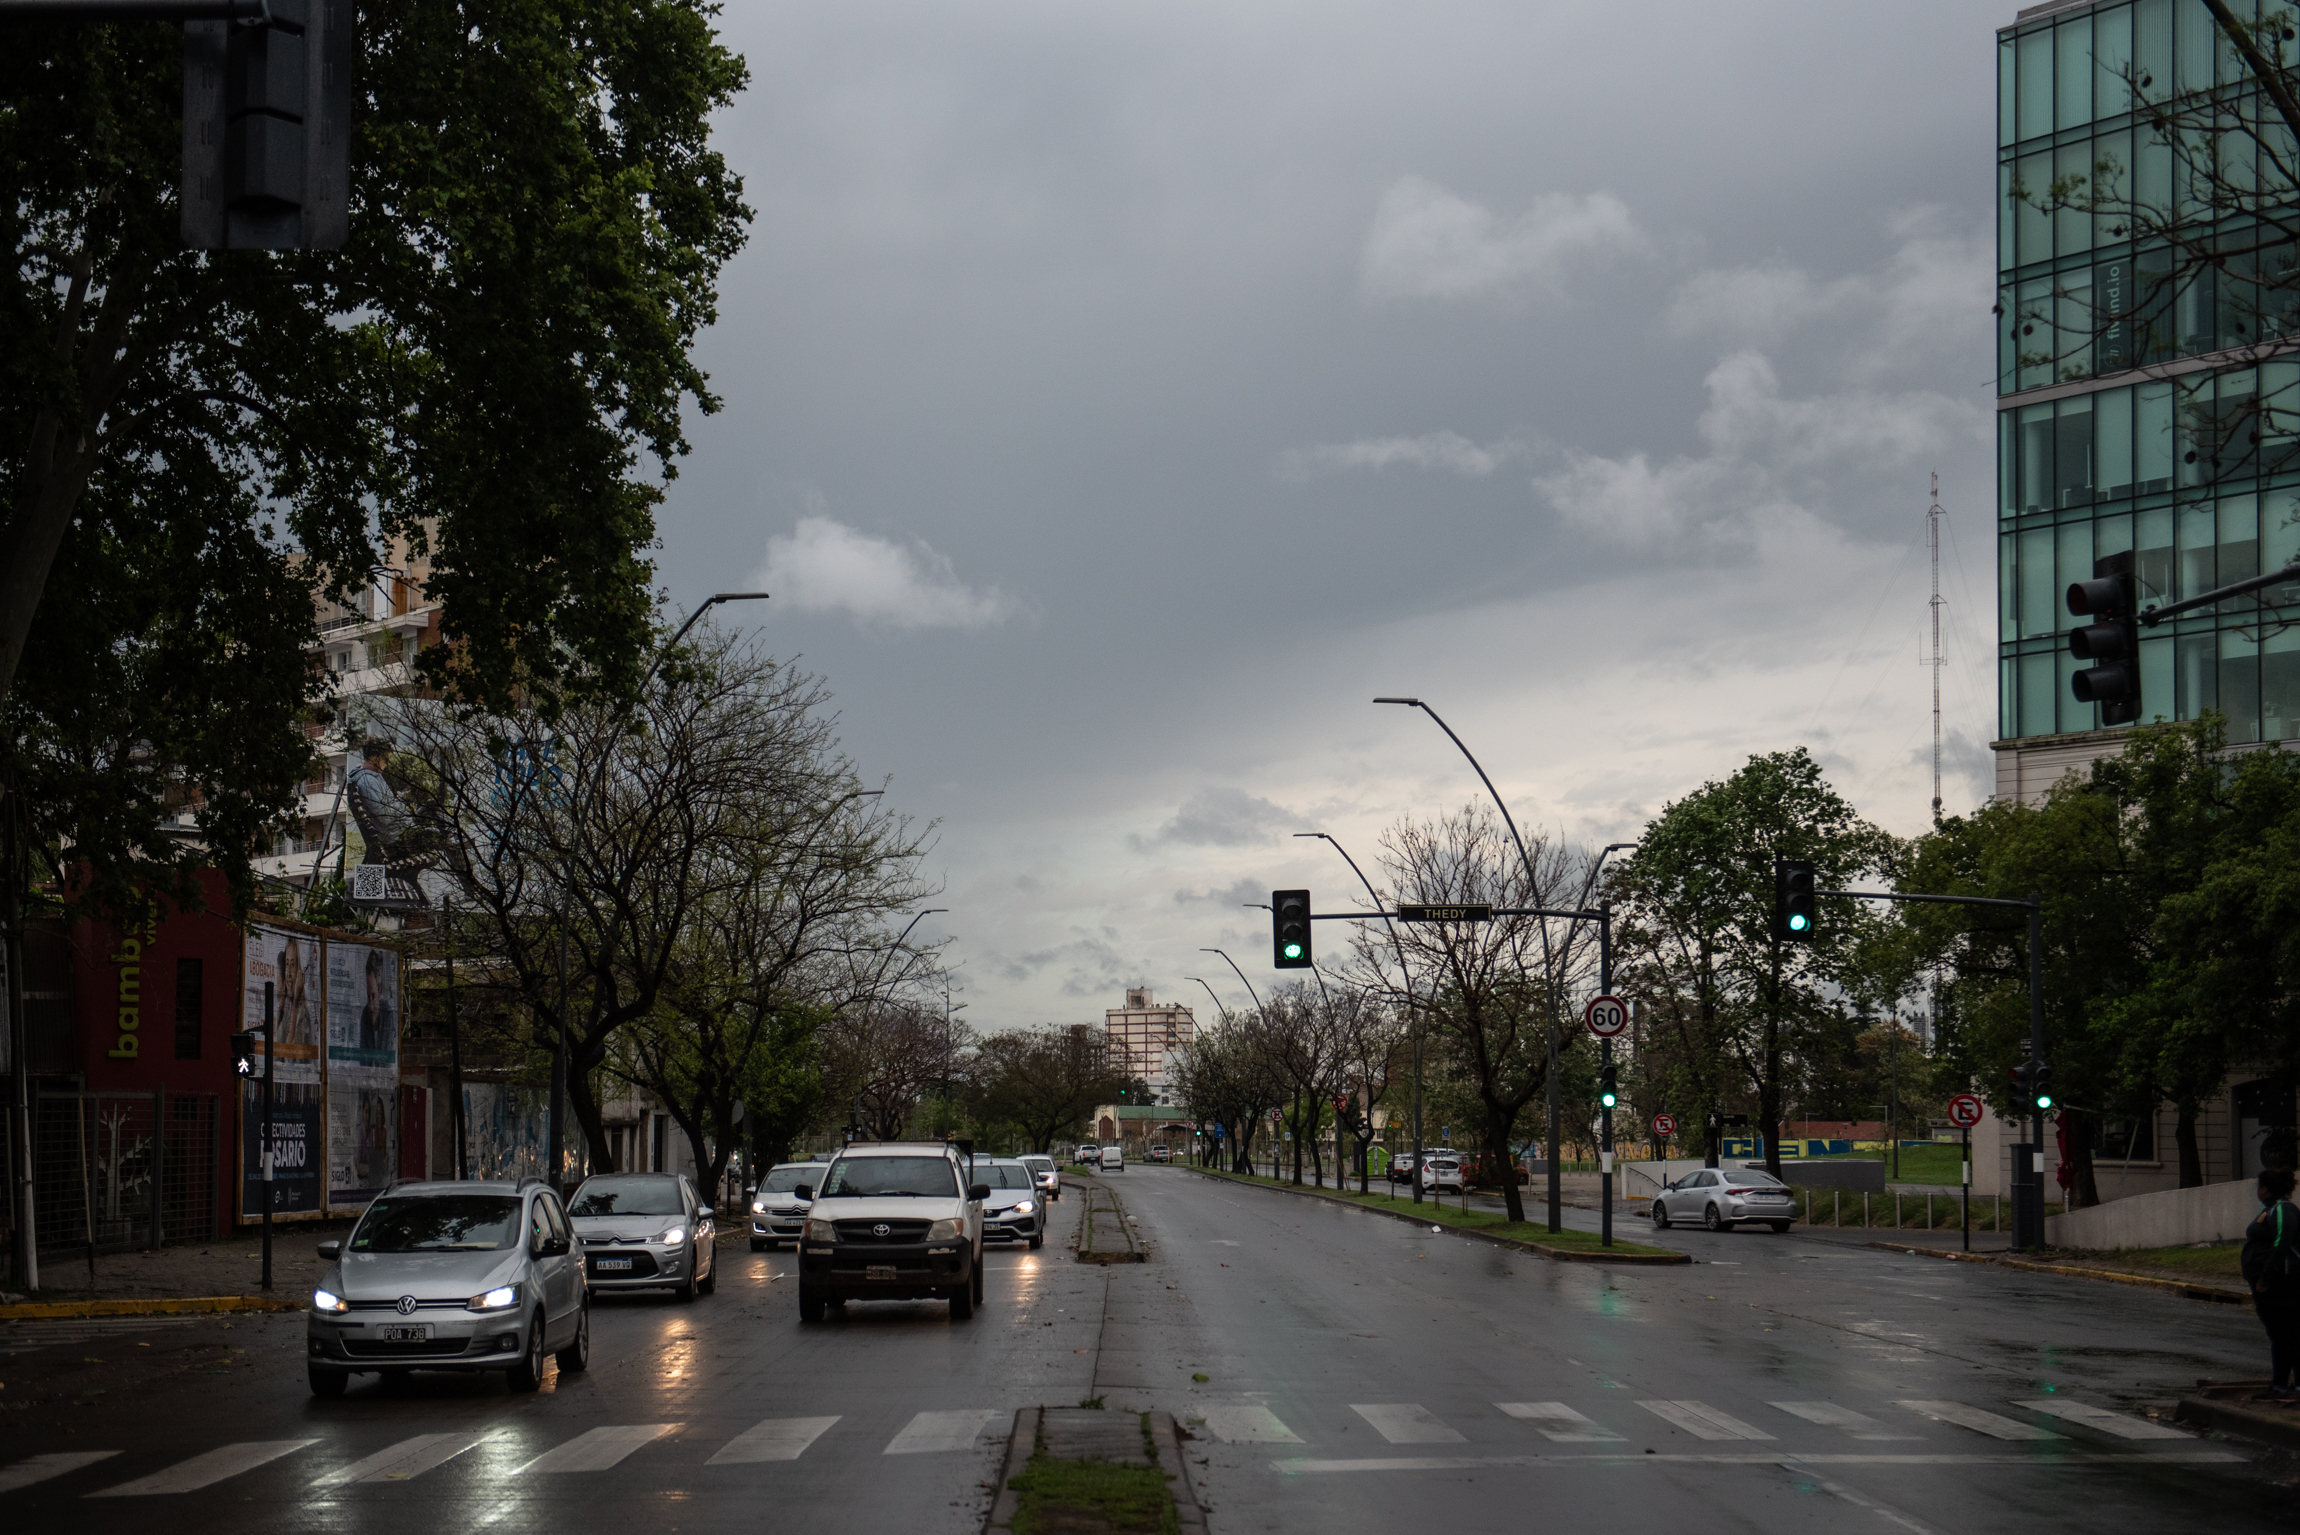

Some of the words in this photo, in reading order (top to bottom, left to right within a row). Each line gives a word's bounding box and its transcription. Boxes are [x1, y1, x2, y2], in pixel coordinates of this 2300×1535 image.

[1423, 908, 1467, 919] THEDY
[107, 886, 142, 1058] bamb
[1593, 1007, 1620, 1026] 60
[260, 1122, 306, 1138] CECTIVIDADES
[259, 1139, 306, 1168] SARIO
[385, 1329, 402, 1340] POA
[407, 1328, 425, 1339] 738
